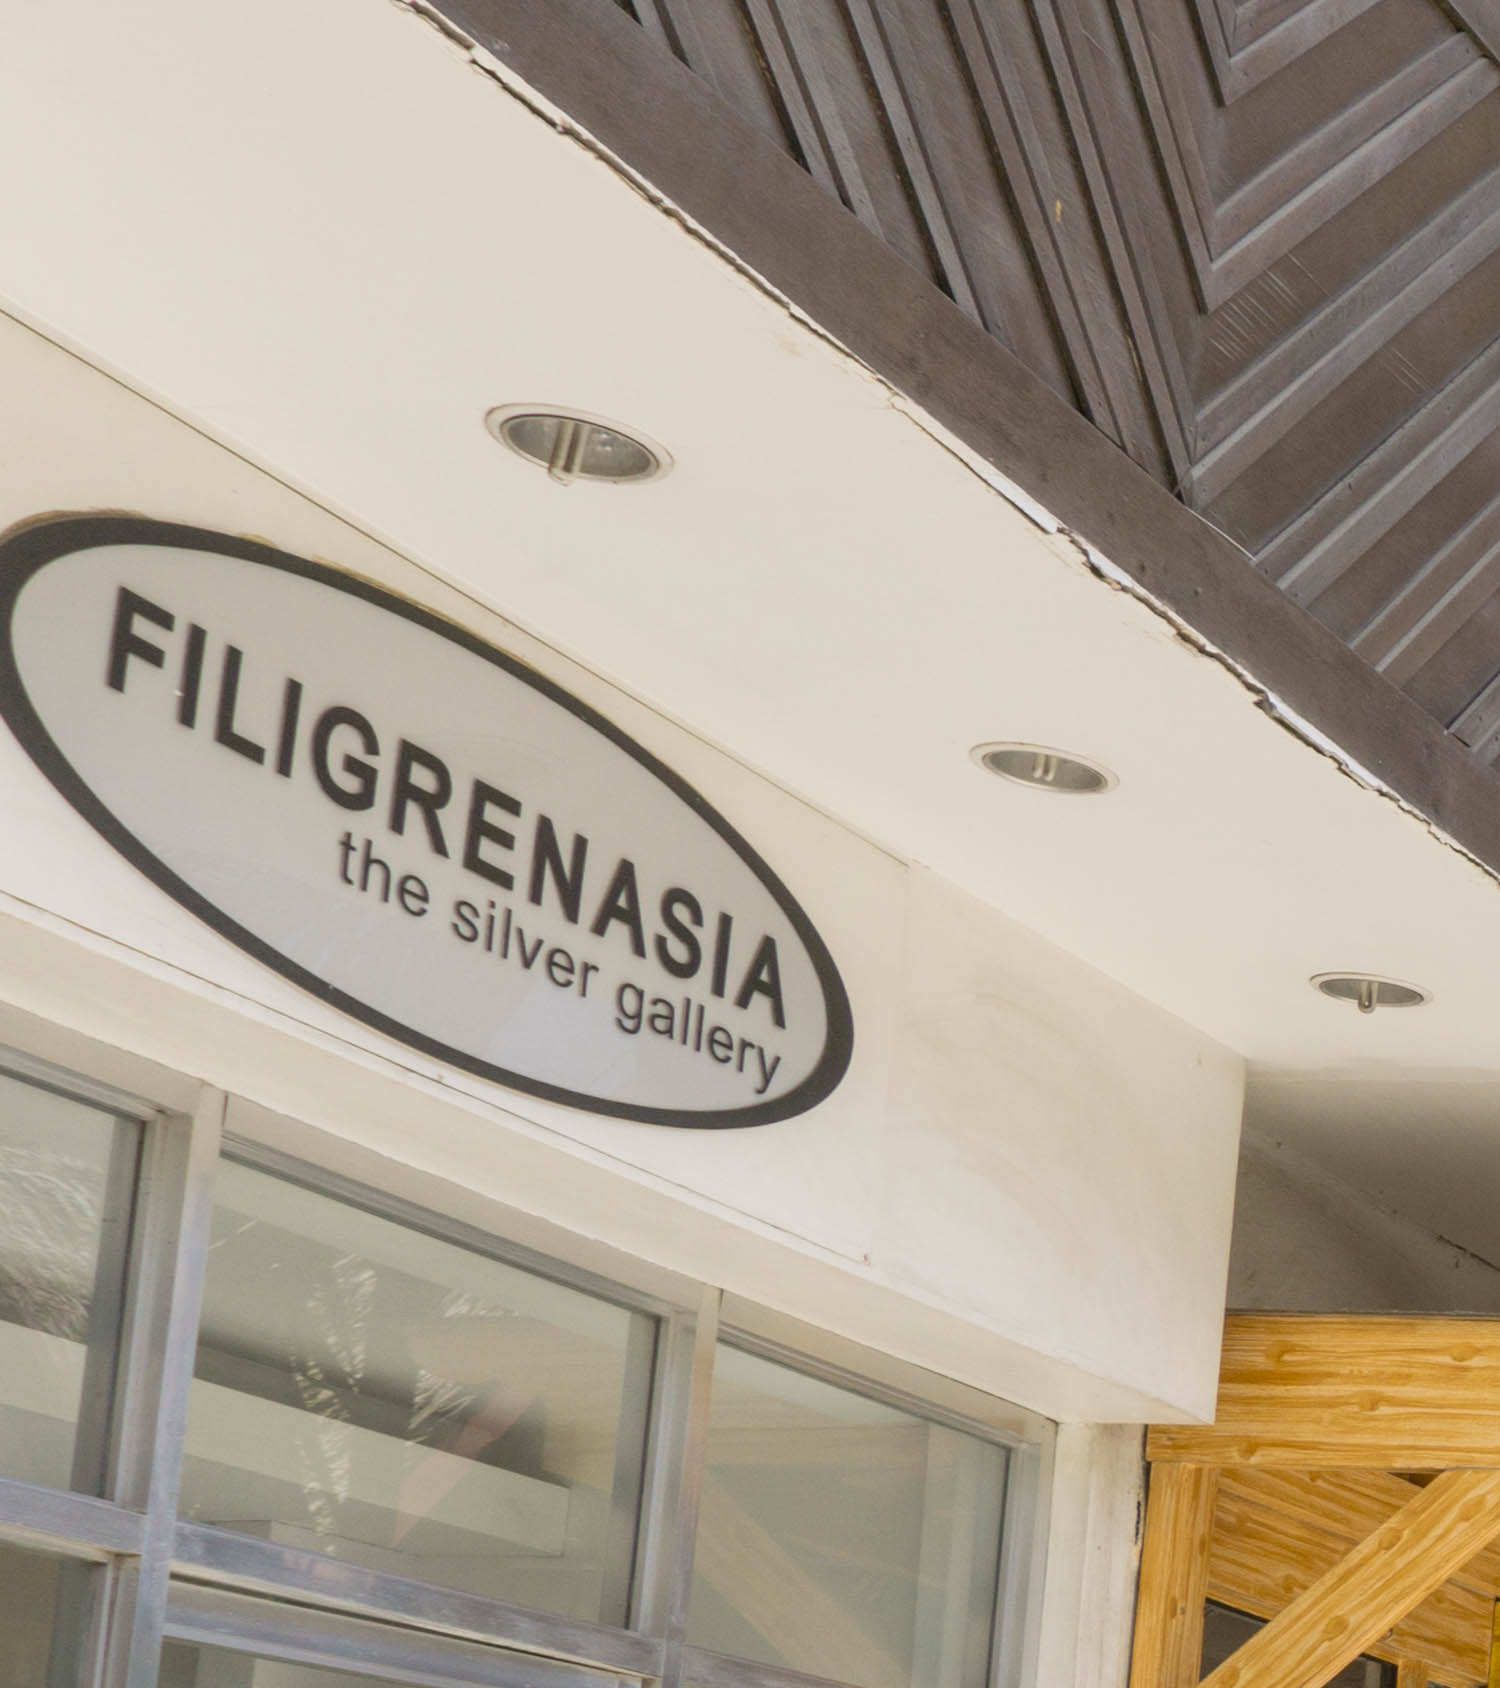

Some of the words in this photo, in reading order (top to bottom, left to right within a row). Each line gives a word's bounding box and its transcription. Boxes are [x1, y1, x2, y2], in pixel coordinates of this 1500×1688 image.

[105, 586, 787, 1030] FILIGRENASIA
[338, 831, 430, 918] the
[450, 892, 601, 998] silver
[614, 980, 783, 1095] gallery
